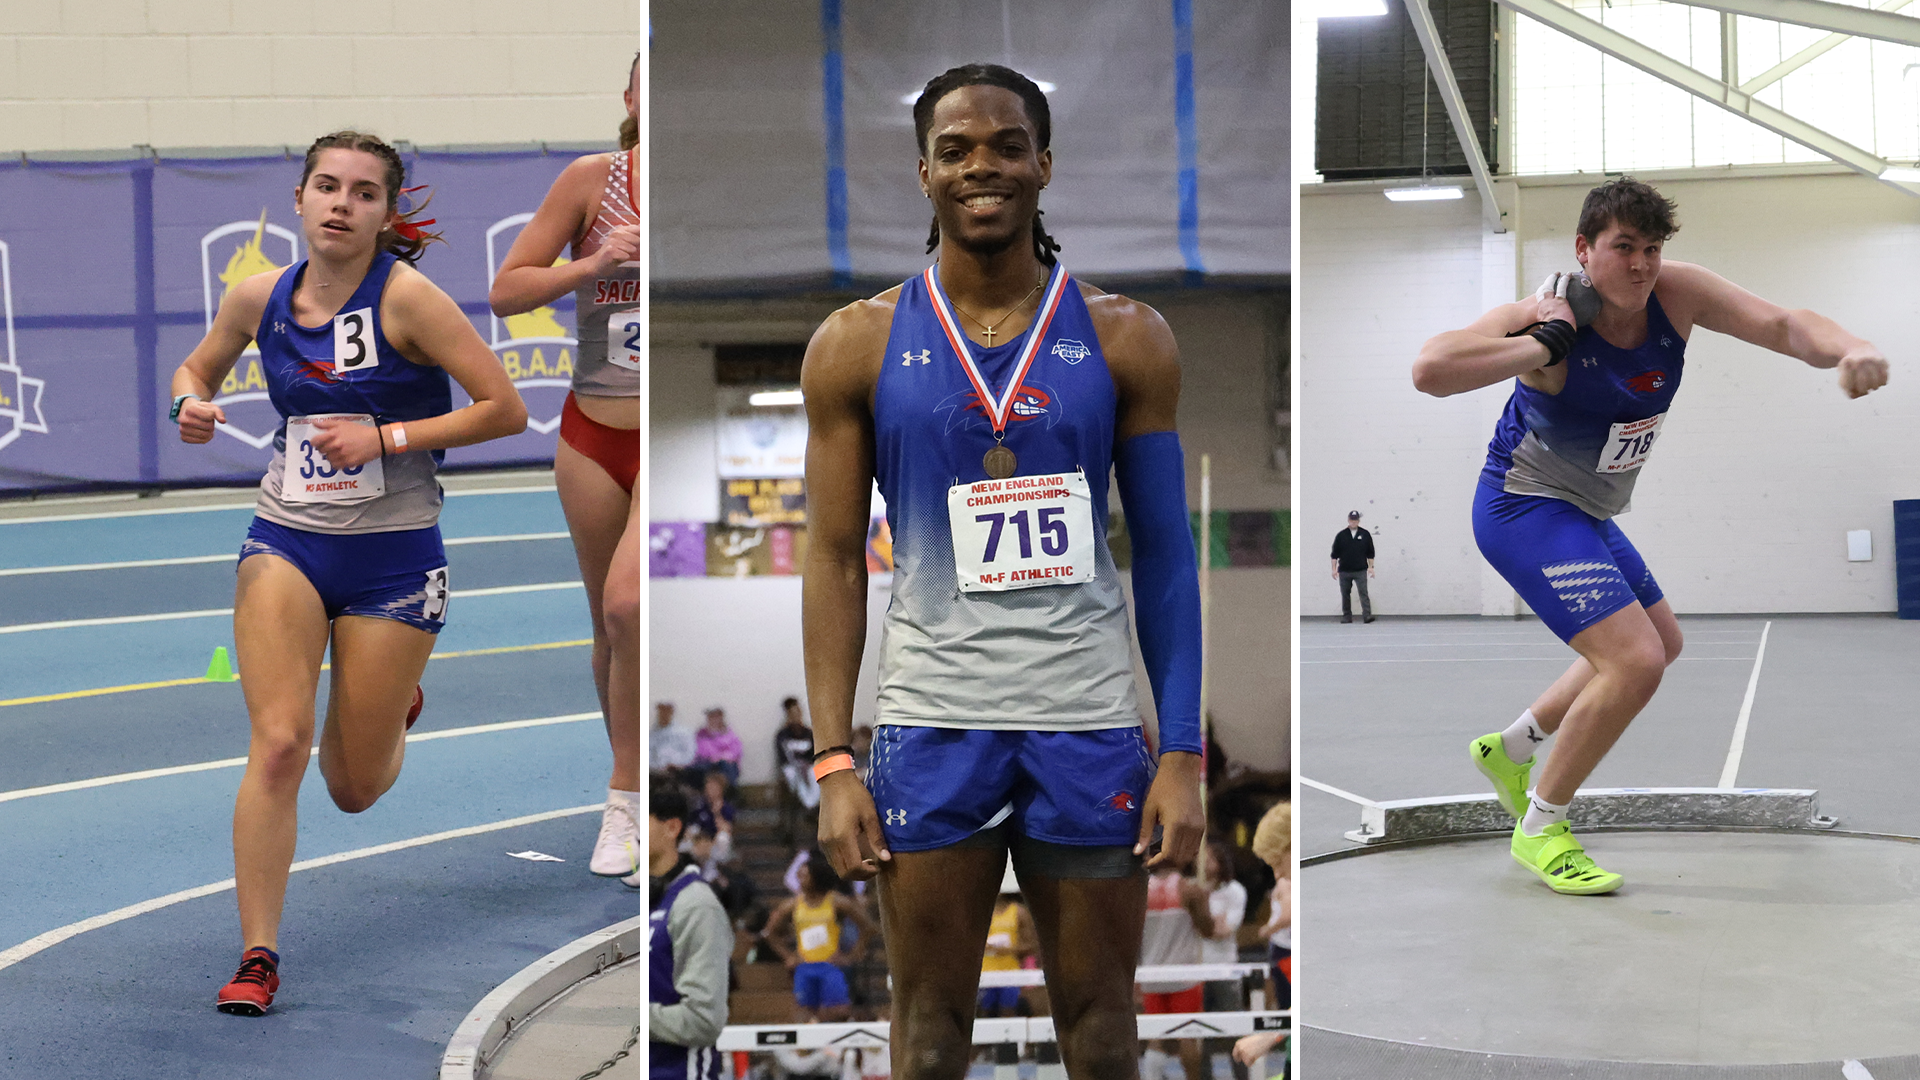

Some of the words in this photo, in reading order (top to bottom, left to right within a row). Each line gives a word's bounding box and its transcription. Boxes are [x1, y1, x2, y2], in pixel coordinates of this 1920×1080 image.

[343, 314, 366, 367] 3
[1053, 344, 1088, 353] AMERICA
[1061, 350, 1081, 358] EAST
[1613, 431, 1654, 460] 718
[315, 480, 359, 492] ATHLETIC
[971, 482, 1002, 494] NEW
[1005, 476, 1064, 490] ENGLAND
[966, 488, 1071, 508] CHAMPIONSHIPS
[975, 506, 1070, 564] 715
[979, 572, 1006, 584] M-F
[1010, 565, 1074, 582] ATHLETIC
